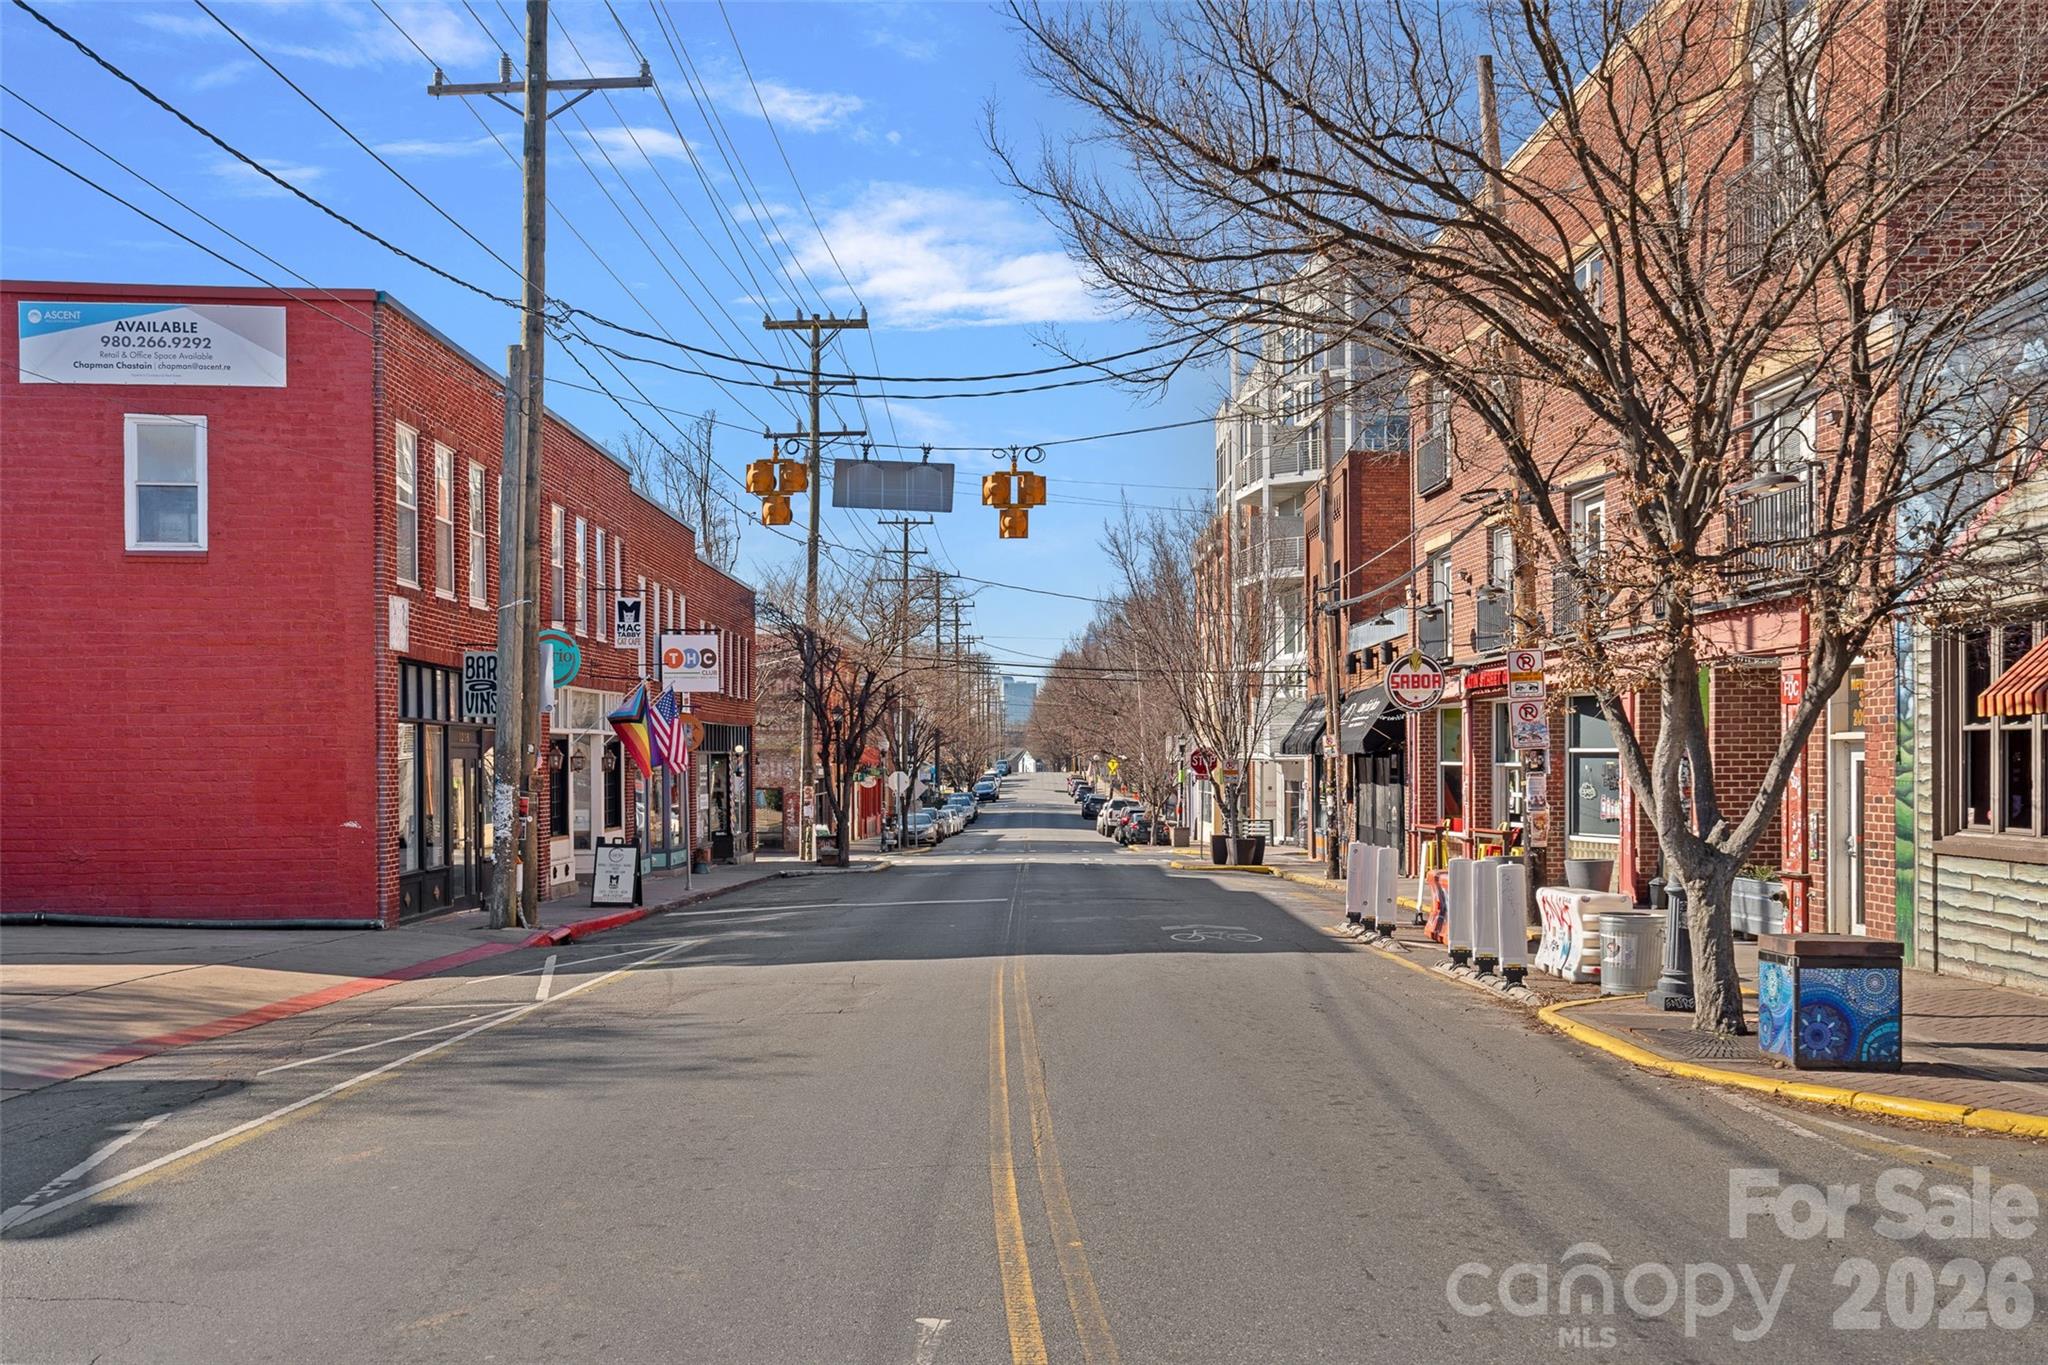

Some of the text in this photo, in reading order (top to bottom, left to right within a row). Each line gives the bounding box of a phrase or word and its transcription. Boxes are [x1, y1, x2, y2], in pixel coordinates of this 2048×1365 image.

[44, 311, 81, 320] ASCENT
[115, 320, 198, 334] AVAILABLE
[100, 336, 212, 350] 980.266.9292
[100, 351, 213, 362] Retail & Office Space Available
[73, 361, 231, 372] Chapman Chastain chapman@ascent.re
[668, 651, 714, 666] THC
[465, 656, 497, 679] BAR
[1391, 674, 1441, 689] SABOR
[1784, 681, 1799, 697] FDC
[465, 691, 497, 714] VINS
[1192, 754, 1217, 767] STP
